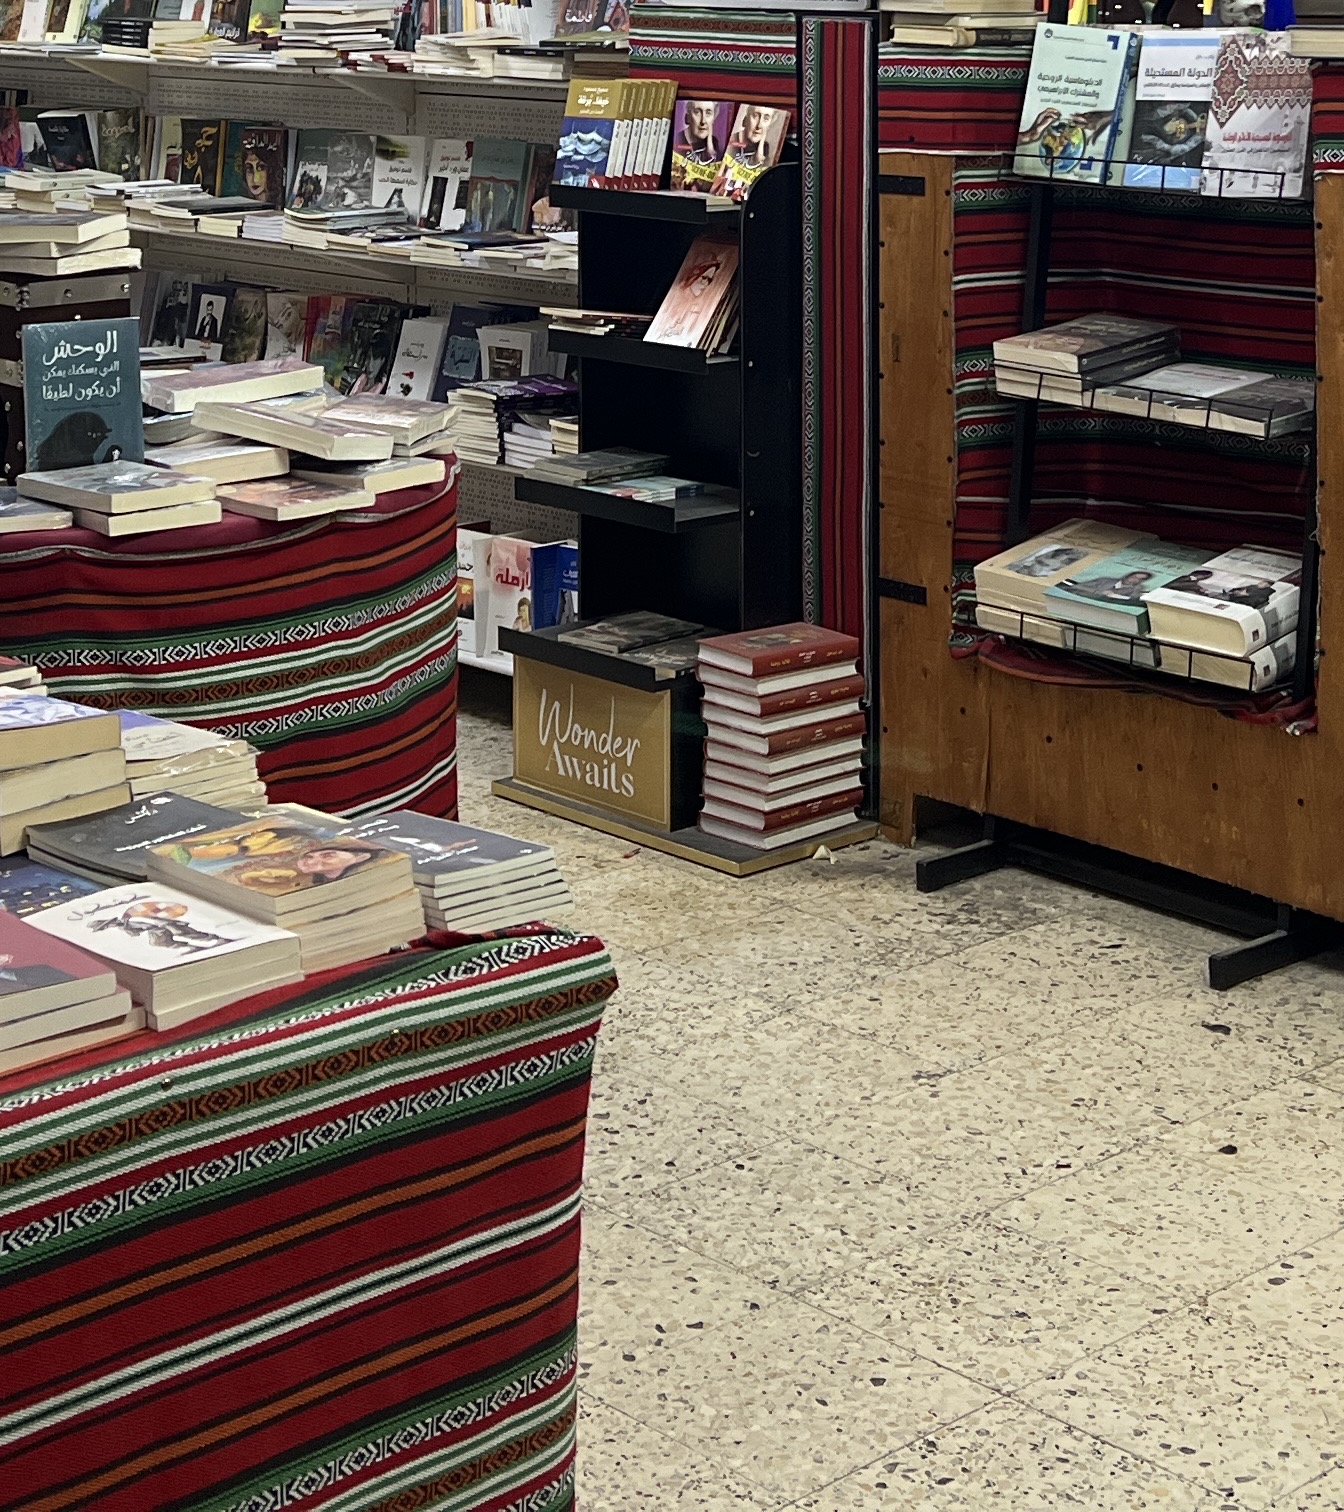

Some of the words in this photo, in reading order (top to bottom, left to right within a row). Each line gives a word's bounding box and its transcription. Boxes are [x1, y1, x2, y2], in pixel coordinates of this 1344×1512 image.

[42, 330, 118, 365] الوحش
[75, 380, 104, 401] يكون
[106, 376, 121, 398] أن
[538, 683, 641, 767] Wonder
[545, 739, 635, 799] Awaits
